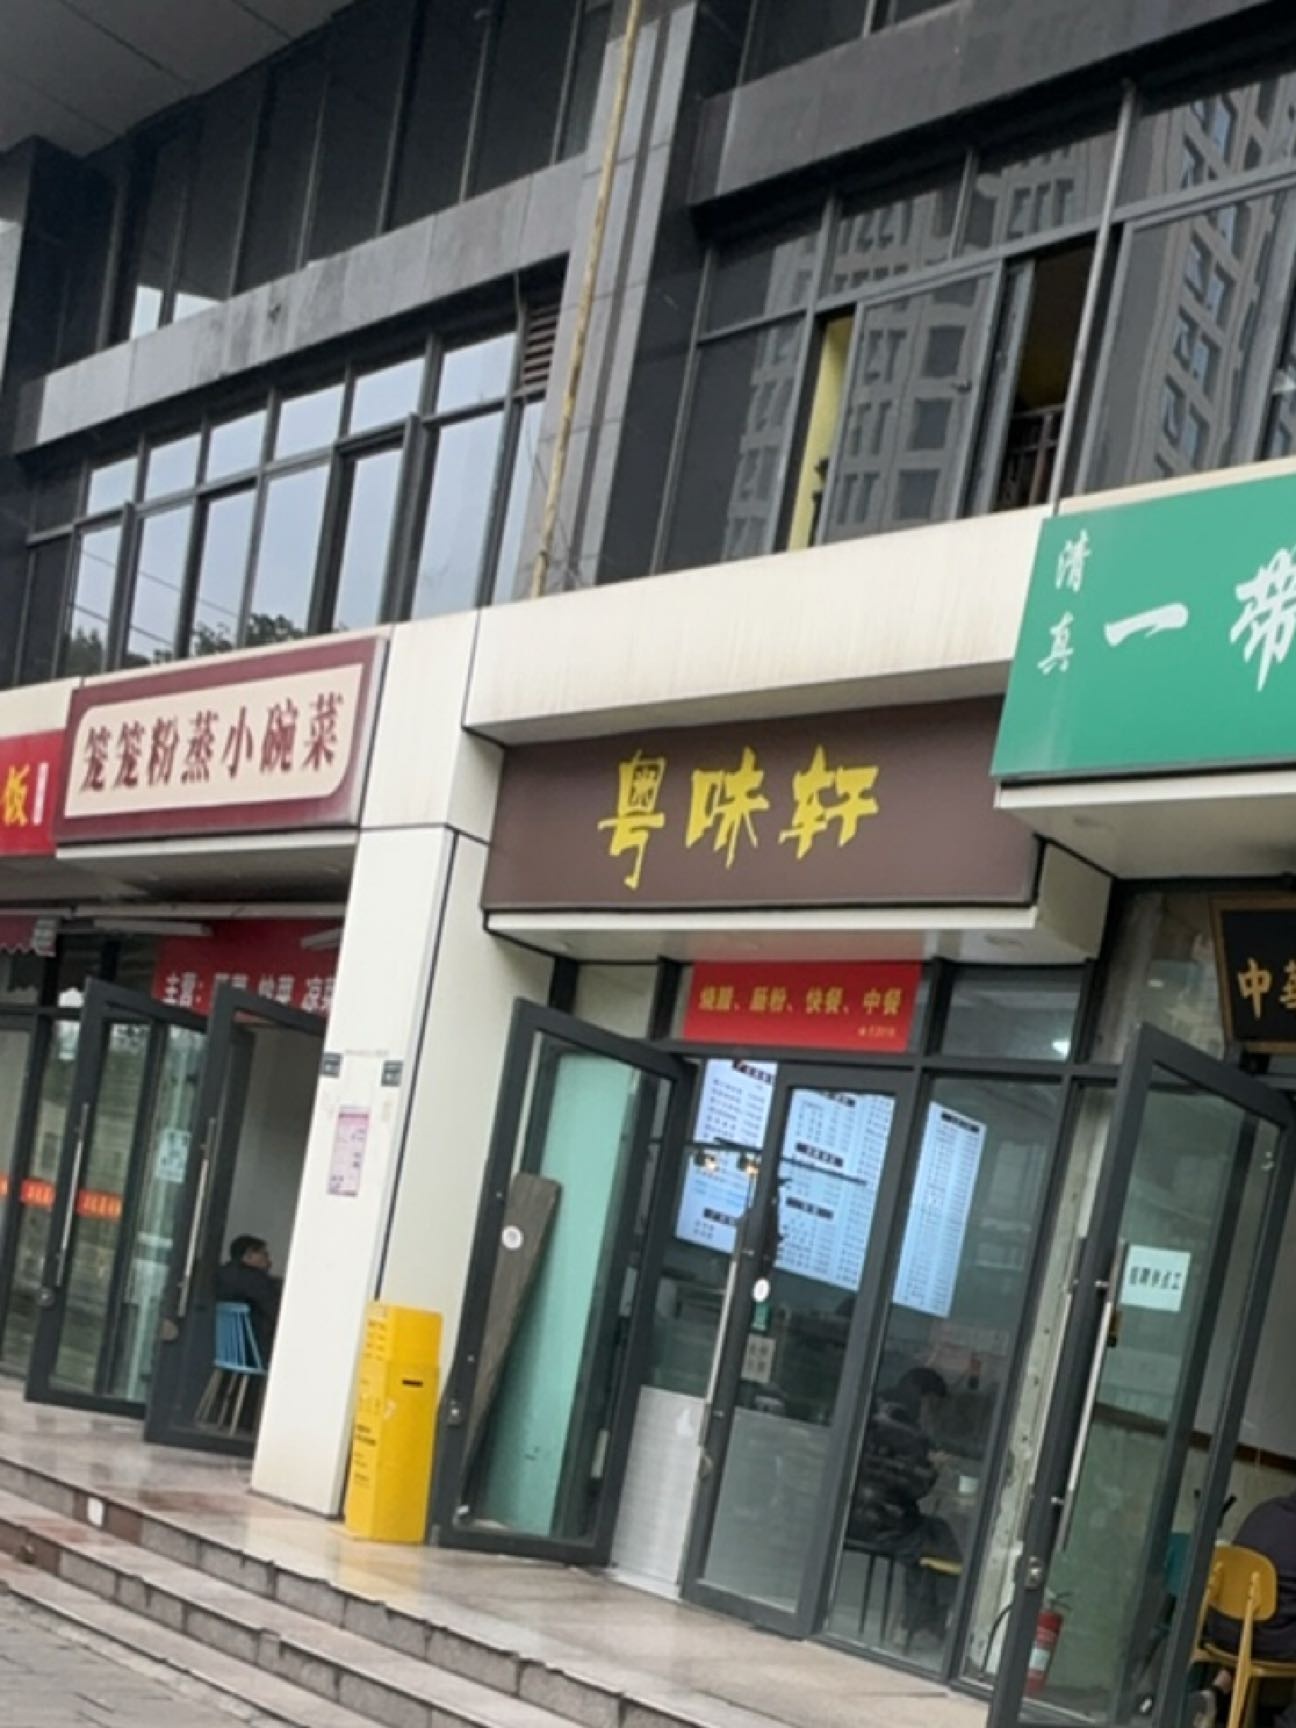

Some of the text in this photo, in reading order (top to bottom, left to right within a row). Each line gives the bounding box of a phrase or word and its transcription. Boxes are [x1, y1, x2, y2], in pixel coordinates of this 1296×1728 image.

[1037, 527, 1092, 675] 清真
[80, 691, 345, 792] 笼笼粉蒸小碗菜
[597, 745, 880, 889] 粤味轩
